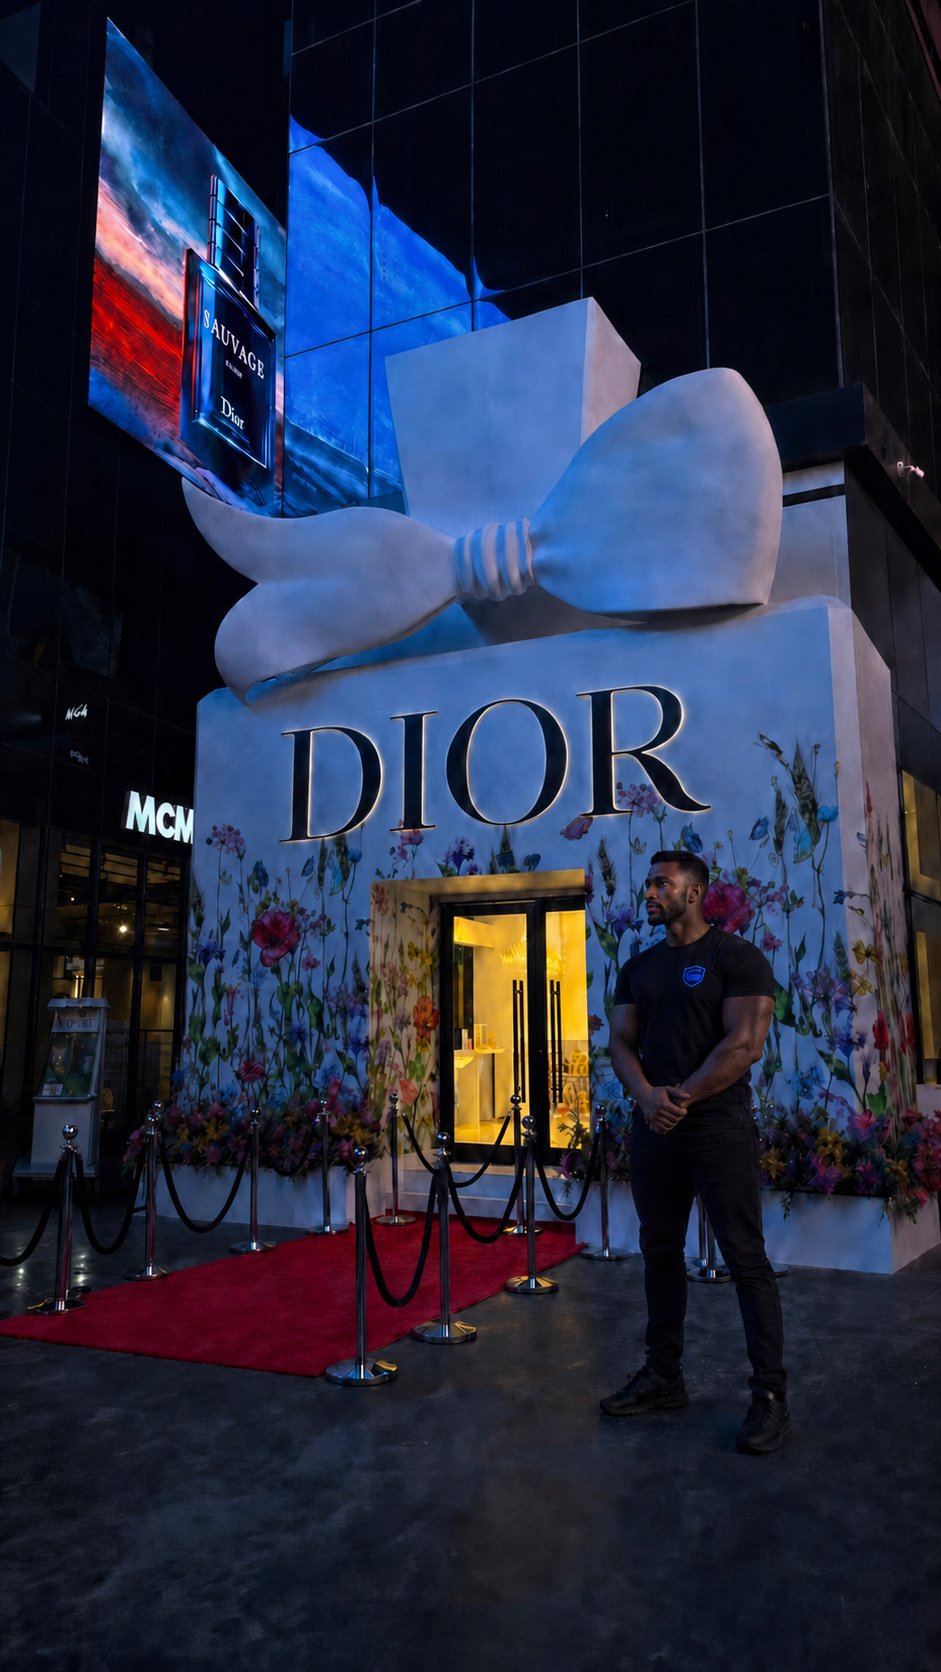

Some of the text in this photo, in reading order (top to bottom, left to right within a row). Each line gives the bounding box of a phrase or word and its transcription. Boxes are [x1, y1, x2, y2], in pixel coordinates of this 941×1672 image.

[203, 309, 265, 379] SAUVAGE
[220, 396, 245, 430] Dior
[279, 684, 712, 843] DIOR
[125, 790, 194, 845] MCM
